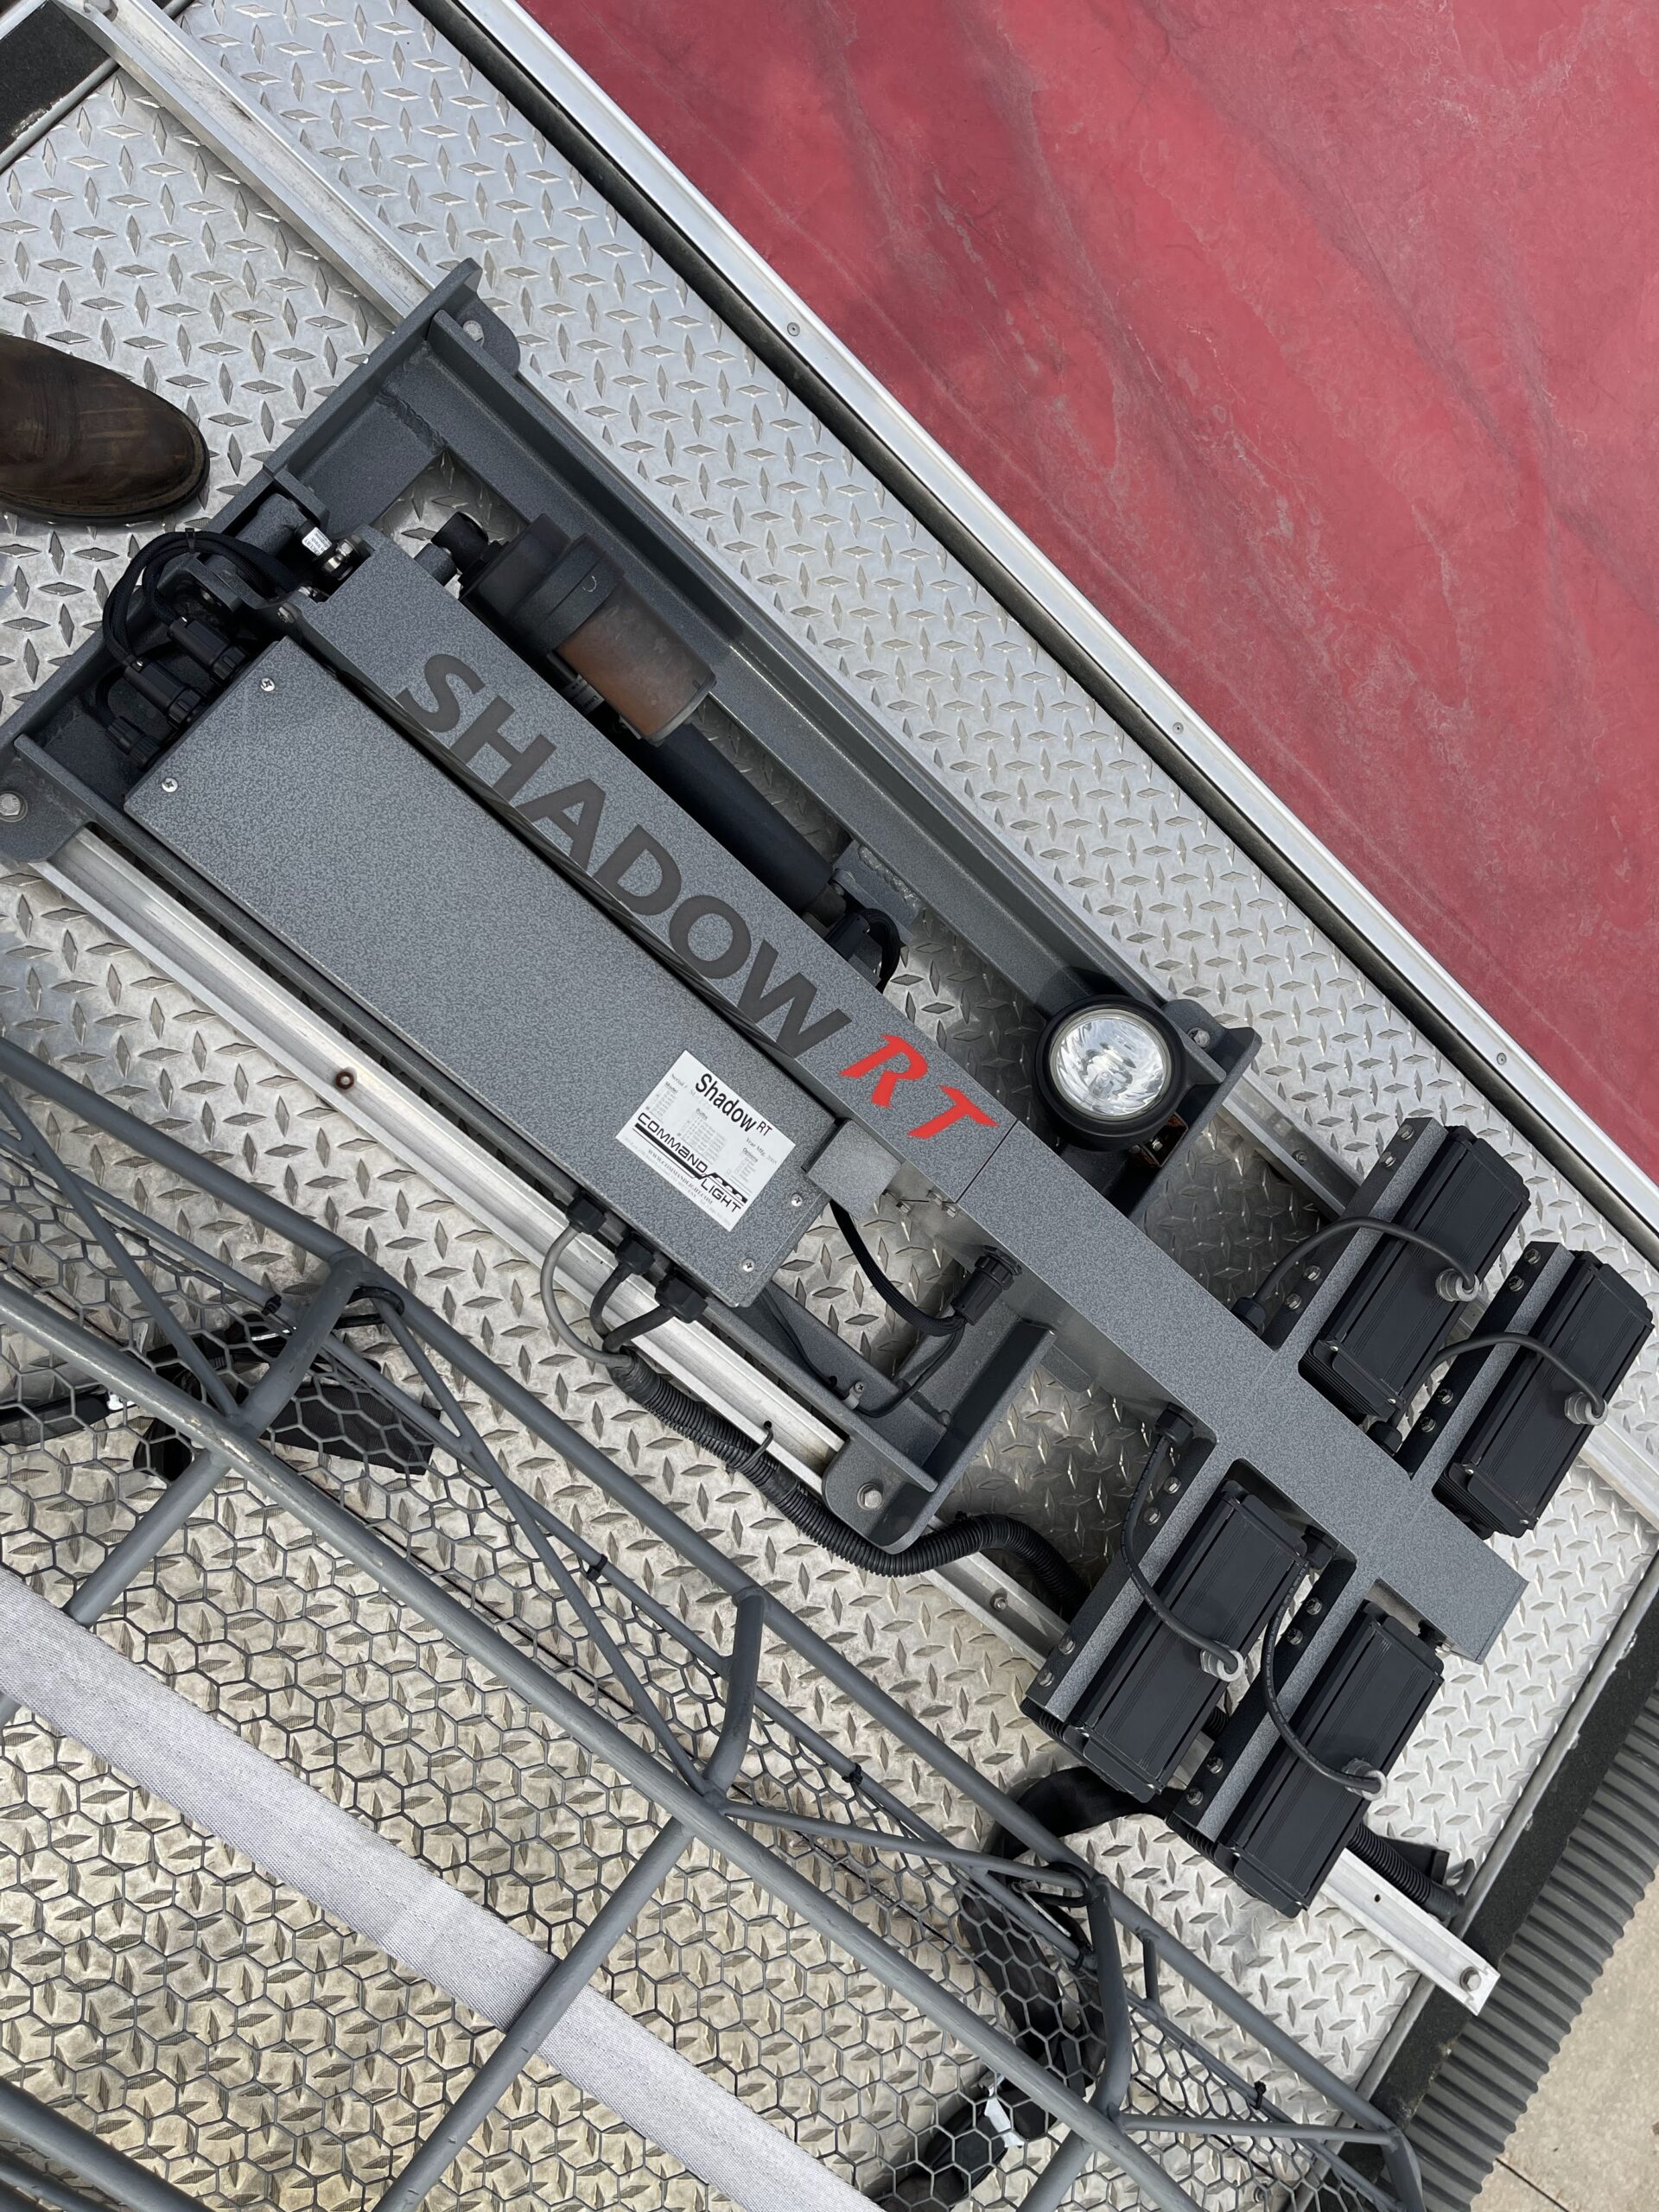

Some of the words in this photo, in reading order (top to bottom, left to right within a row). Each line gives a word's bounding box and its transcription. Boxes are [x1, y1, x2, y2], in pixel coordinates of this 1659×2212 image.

[398, 654, 852, 1059] SHADOW
[840, 1034, 998, 1138] RT
[695, 1073, 757, 1132] Shadow
[757, 1121, 772, 1136] RT
[637, 1113, 708, 1173] COMMAND
[701, 1178, 741, 1212] LIGHT
